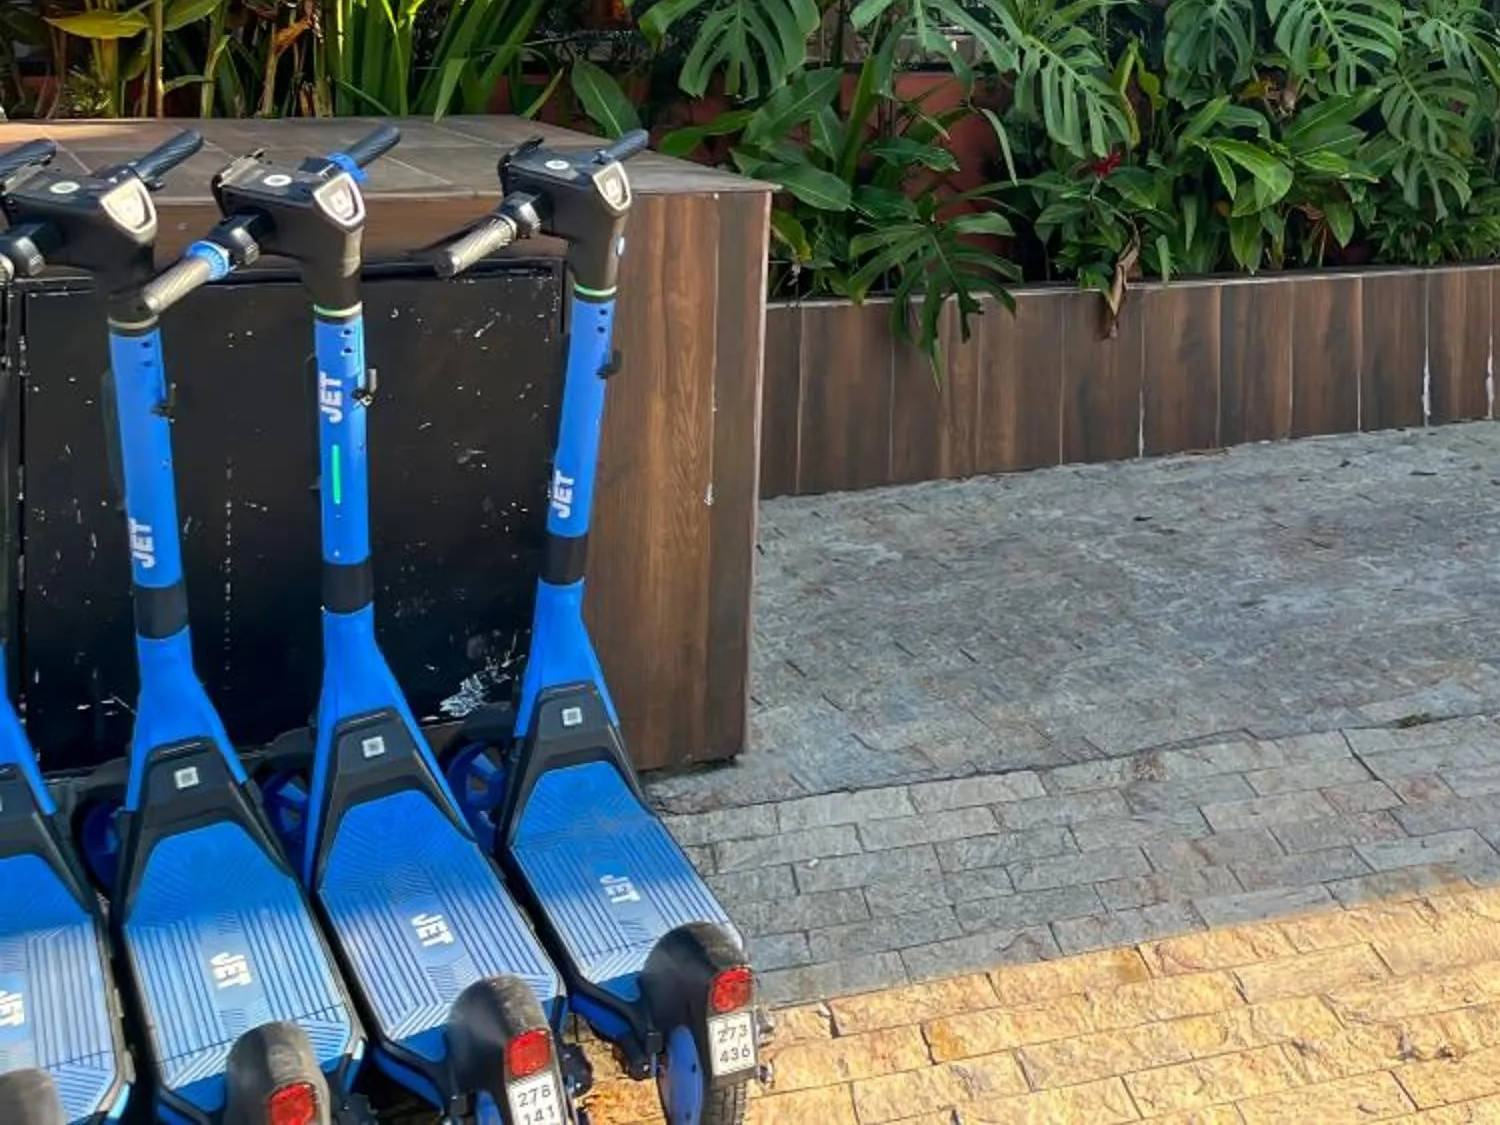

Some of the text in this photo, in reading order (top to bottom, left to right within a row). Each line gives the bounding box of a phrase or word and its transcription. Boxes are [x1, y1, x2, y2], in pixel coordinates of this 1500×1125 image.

[319, 370, 344, 424] JET
[551, 469, 575, 519] JET
[127, 516, 156, 569] JET
[600, 874, 641, 904] JET
[411, 913, 454, 948] JET
[210, 951, 252, 990] JET
